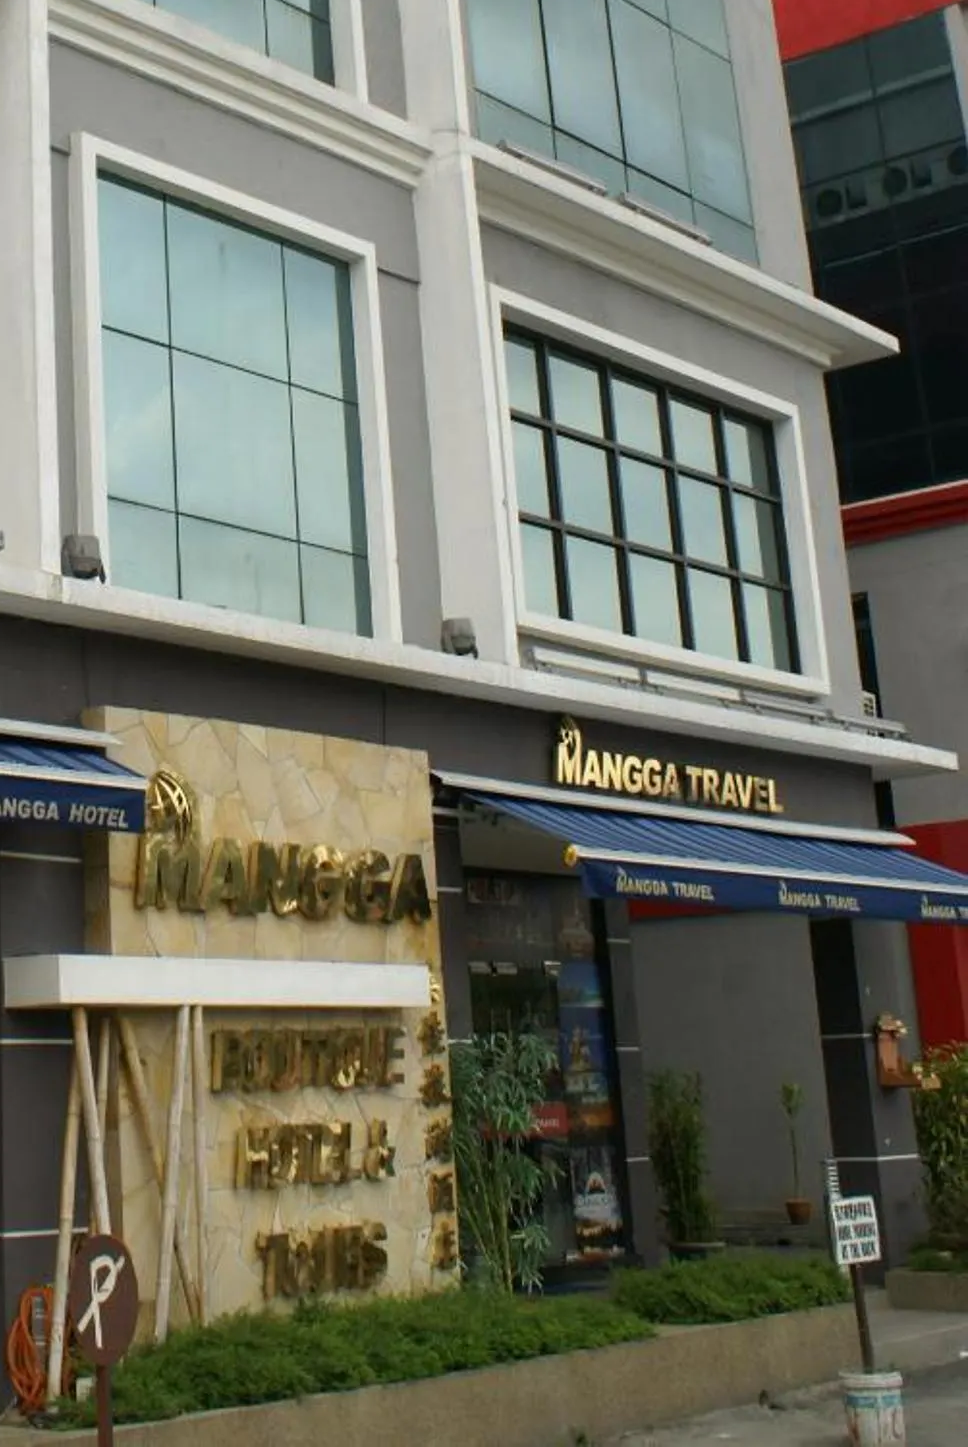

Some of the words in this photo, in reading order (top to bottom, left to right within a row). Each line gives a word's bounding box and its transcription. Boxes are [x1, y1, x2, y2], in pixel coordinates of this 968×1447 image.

[557, 722, 681, 800] MANGGA
[684, 764, 785, 814] TRAVEL
[68, 802, 129, 829] HOTEL
[133, 802, 433, 924] MANGGA
[672, 882, 714, 901] TRAVEL
[824, 894, 861, 913] TRAVEL
